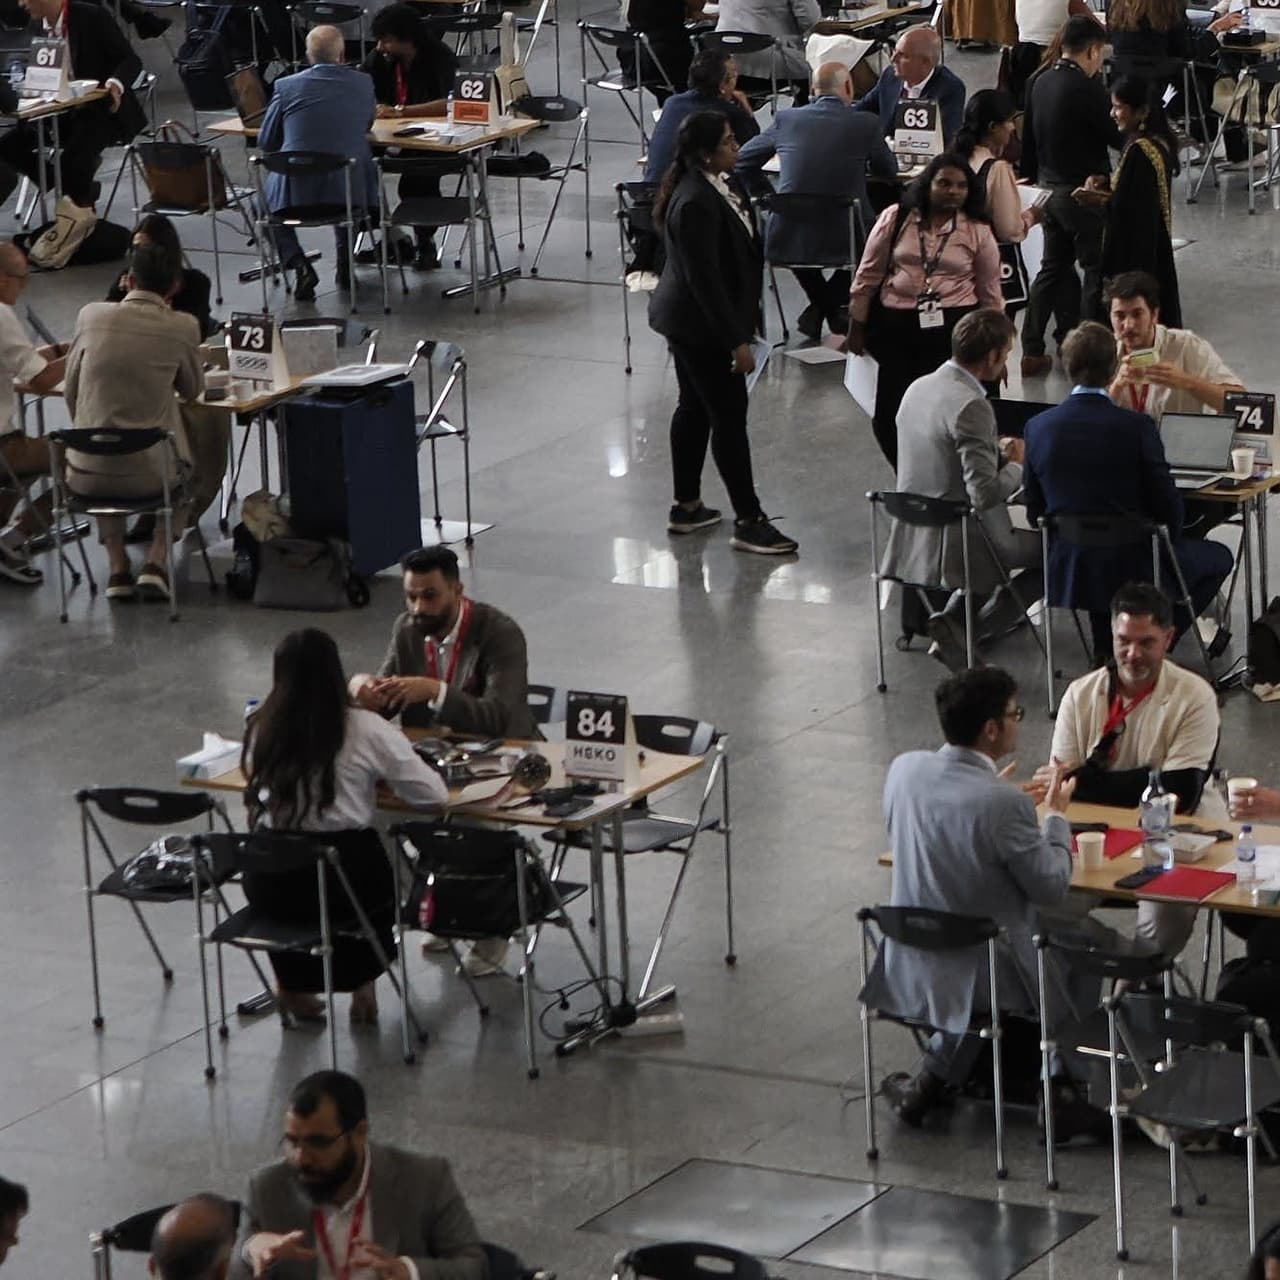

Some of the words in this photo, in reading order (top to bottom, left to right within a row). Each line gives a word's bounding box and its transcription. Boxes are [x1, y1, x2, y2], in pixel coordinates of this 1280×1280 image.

[36, 49, 57, 66] 61
[460, 81, 483, 99] 62
[903, 108, 928, 128] 63
[238, 326, 264, 348] 73
[1235, 406, 1264, 429] 74
[577, 708, 615, 738] 84
